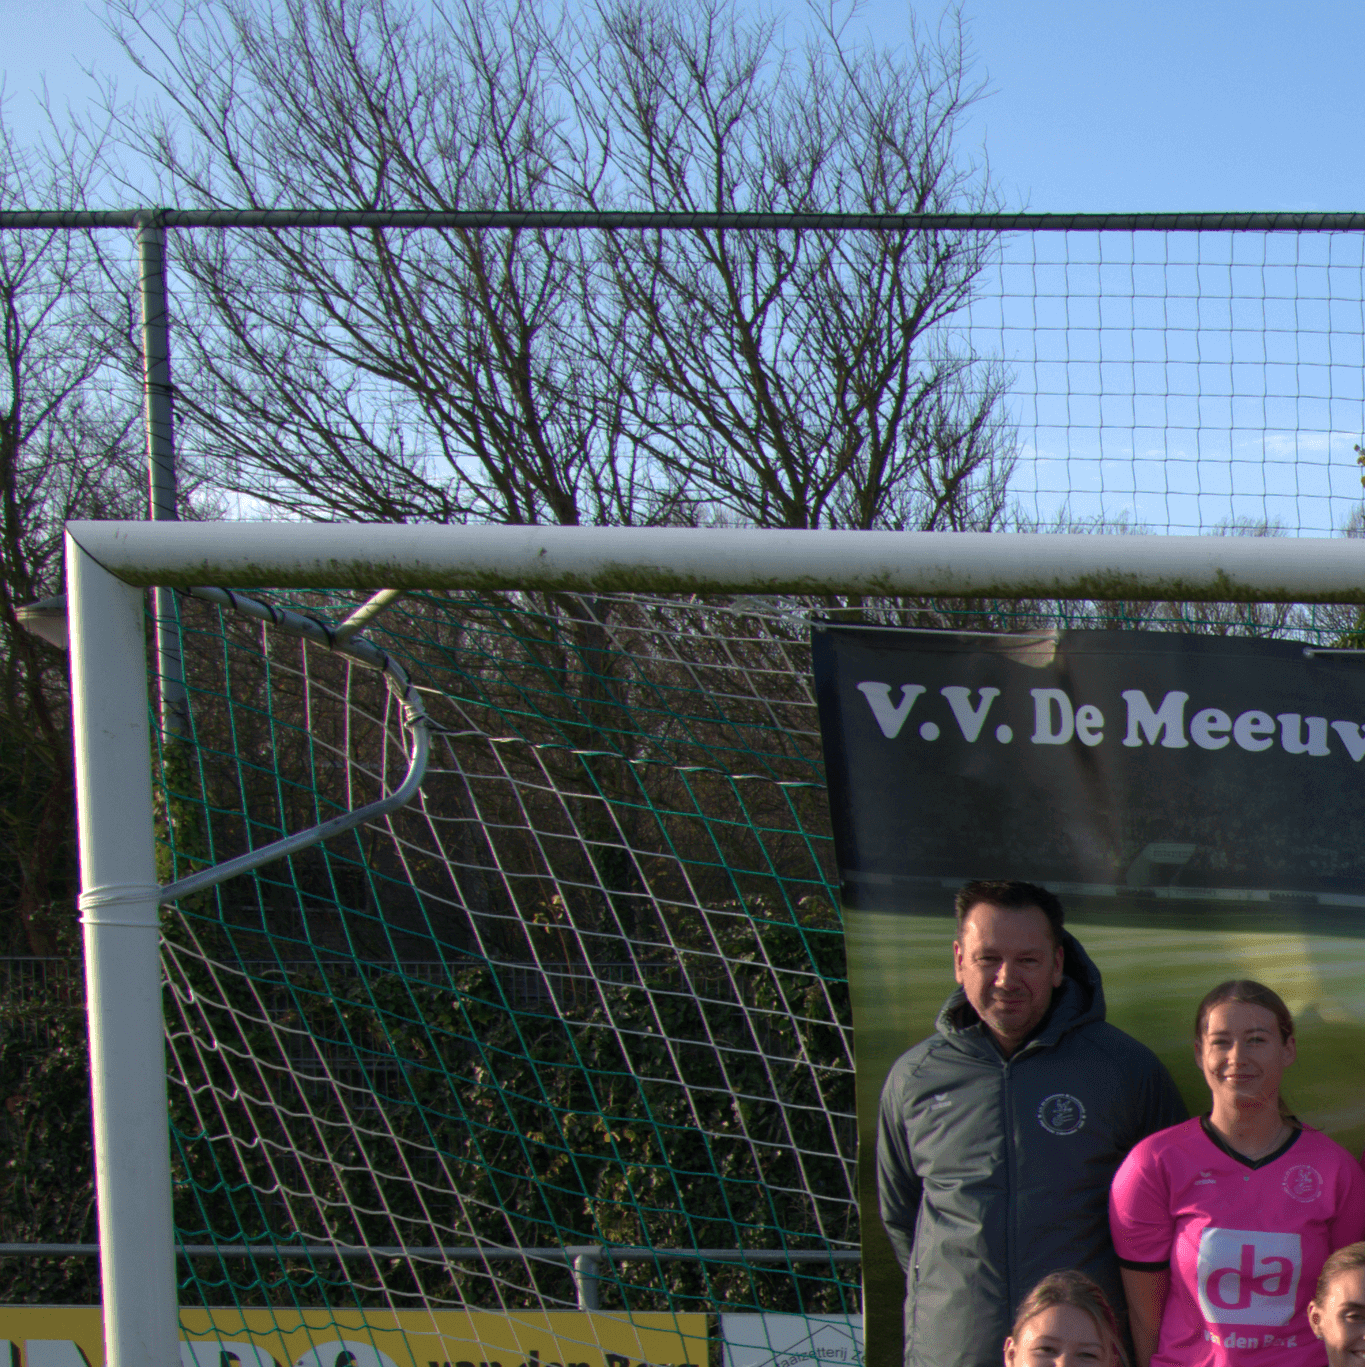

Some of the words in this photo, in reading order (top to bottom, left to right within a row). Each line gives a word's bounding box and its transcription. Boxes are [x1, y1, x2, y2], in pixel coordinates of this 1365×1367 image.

[857, 681, 1013, 744] V.V.
[1030, 688, 1105, 747] De
[1206, 1245, 1295, 1310] da
[1224, 1332, 1258, 1349] den
